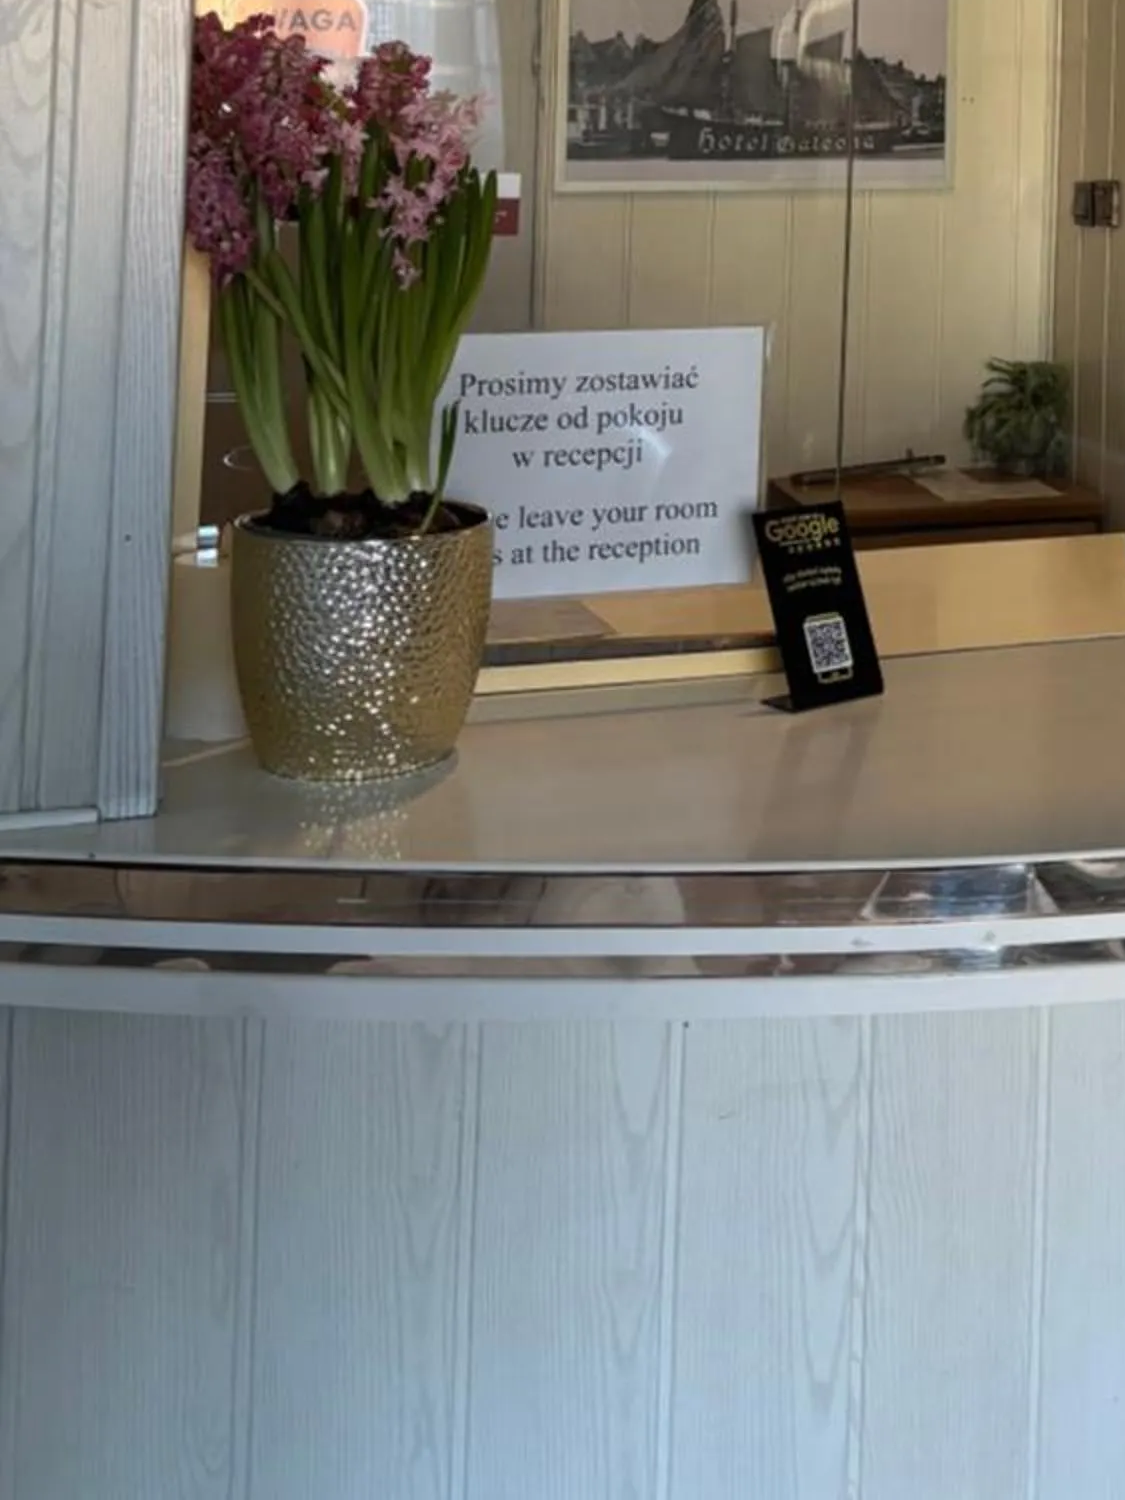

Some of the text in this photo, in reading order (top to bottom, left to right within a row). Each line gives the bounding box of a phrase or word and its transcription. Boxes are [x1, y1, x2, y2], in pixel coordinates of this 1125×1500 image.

[459, 366, 700, 400] Prosimy zostawiać
[464, 402, 684, 435] klucze od pokoju
[512, 438, 643, 471] w recepcji
[519, 505, 584, 529] leave
[591, 504, 648, 531] your
[655, 500, 718, 521] room
[764, 516, 839, 541] Google
[511, 545, 534, 565] at
[542, 540, 580, 563] the
[588, 533, 701, 563] reception
